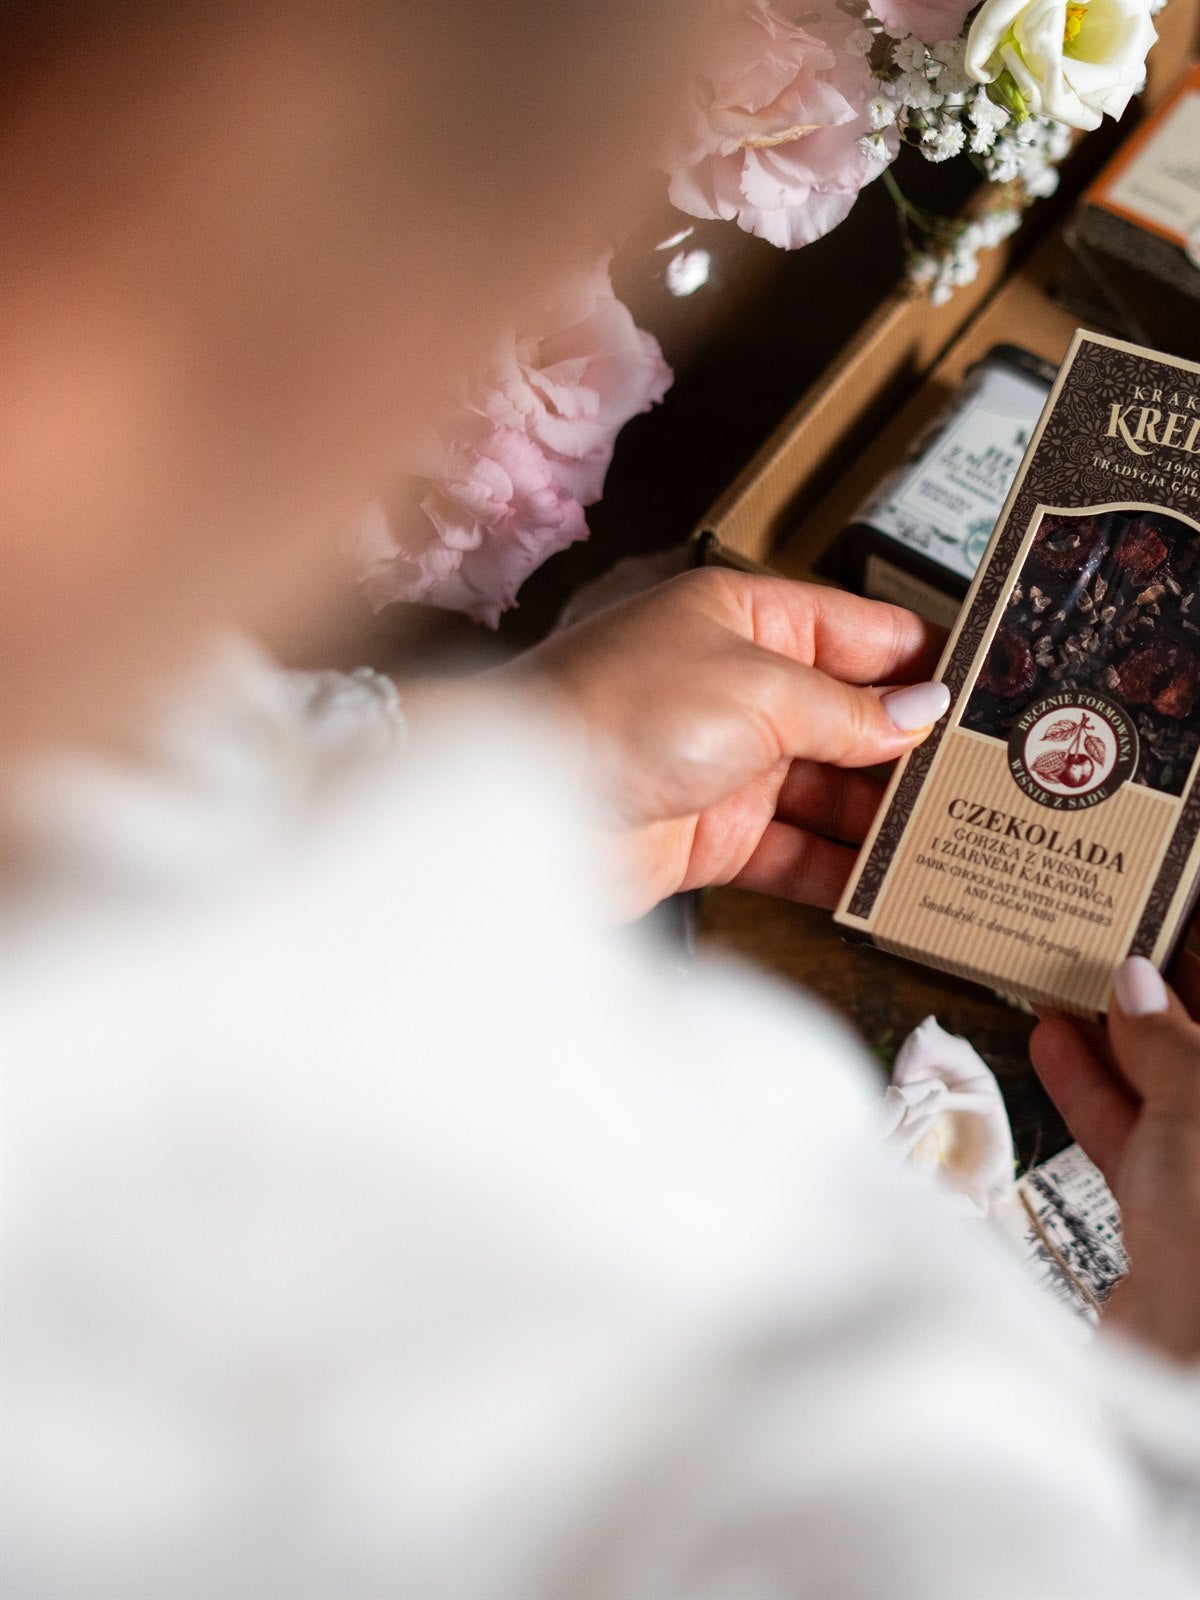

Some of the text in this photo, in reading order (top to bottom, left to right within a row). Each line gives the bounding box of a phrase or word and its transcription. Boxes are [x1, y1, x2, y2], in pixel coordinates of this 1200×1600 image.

[1092, 456, 1165, 487] TRADYCJA
[1018, 693, 1132, 762] RĘCZNIE FORMOWANA
[1010, 758, 1109, 809] WIŚNIE Z SADU
[948, 798, 1125, 874] CZEKOLADA
[954, 827, 1099, 889] GORZKA Z WIŚNIĄ
[916, 853, 1114, 928] DARK CHOCOLATE WITH CHERRIES
[931, 837, 1113, 909] I ZIARNEM KAKAOWCA
[919, 894, 977, 926] Smakołyk
[964, 885, 1057, 924] AND CACAO NIBS
